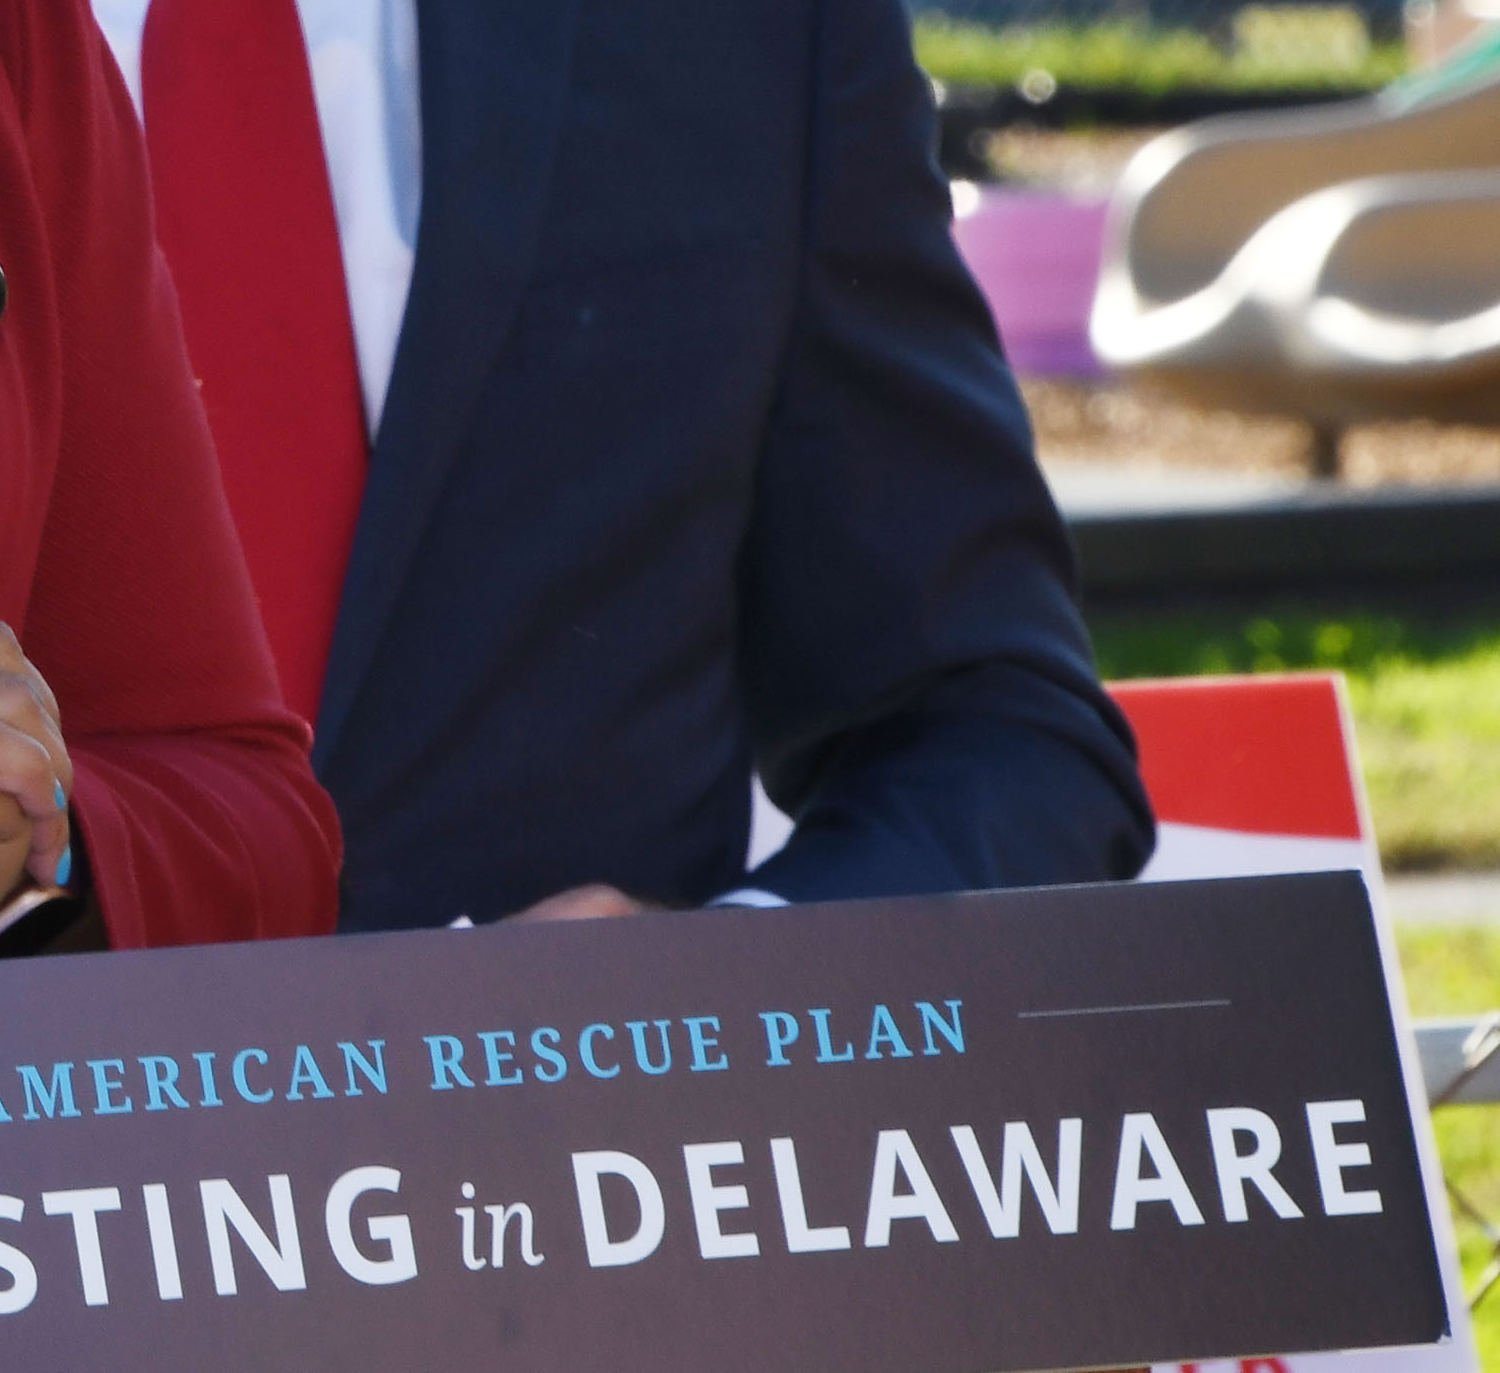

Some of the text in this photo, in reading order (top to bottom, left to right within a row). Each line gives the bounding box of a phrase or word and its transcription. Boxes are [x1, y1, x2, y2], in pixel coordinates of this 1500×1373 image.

[423, 1018, 731, 1092] RESCUE
[759, 999, 967, 1067] PLAN
[454, 1182, 545, 1272] in
[571, 1098, 1384, 1269] DELAWARE
